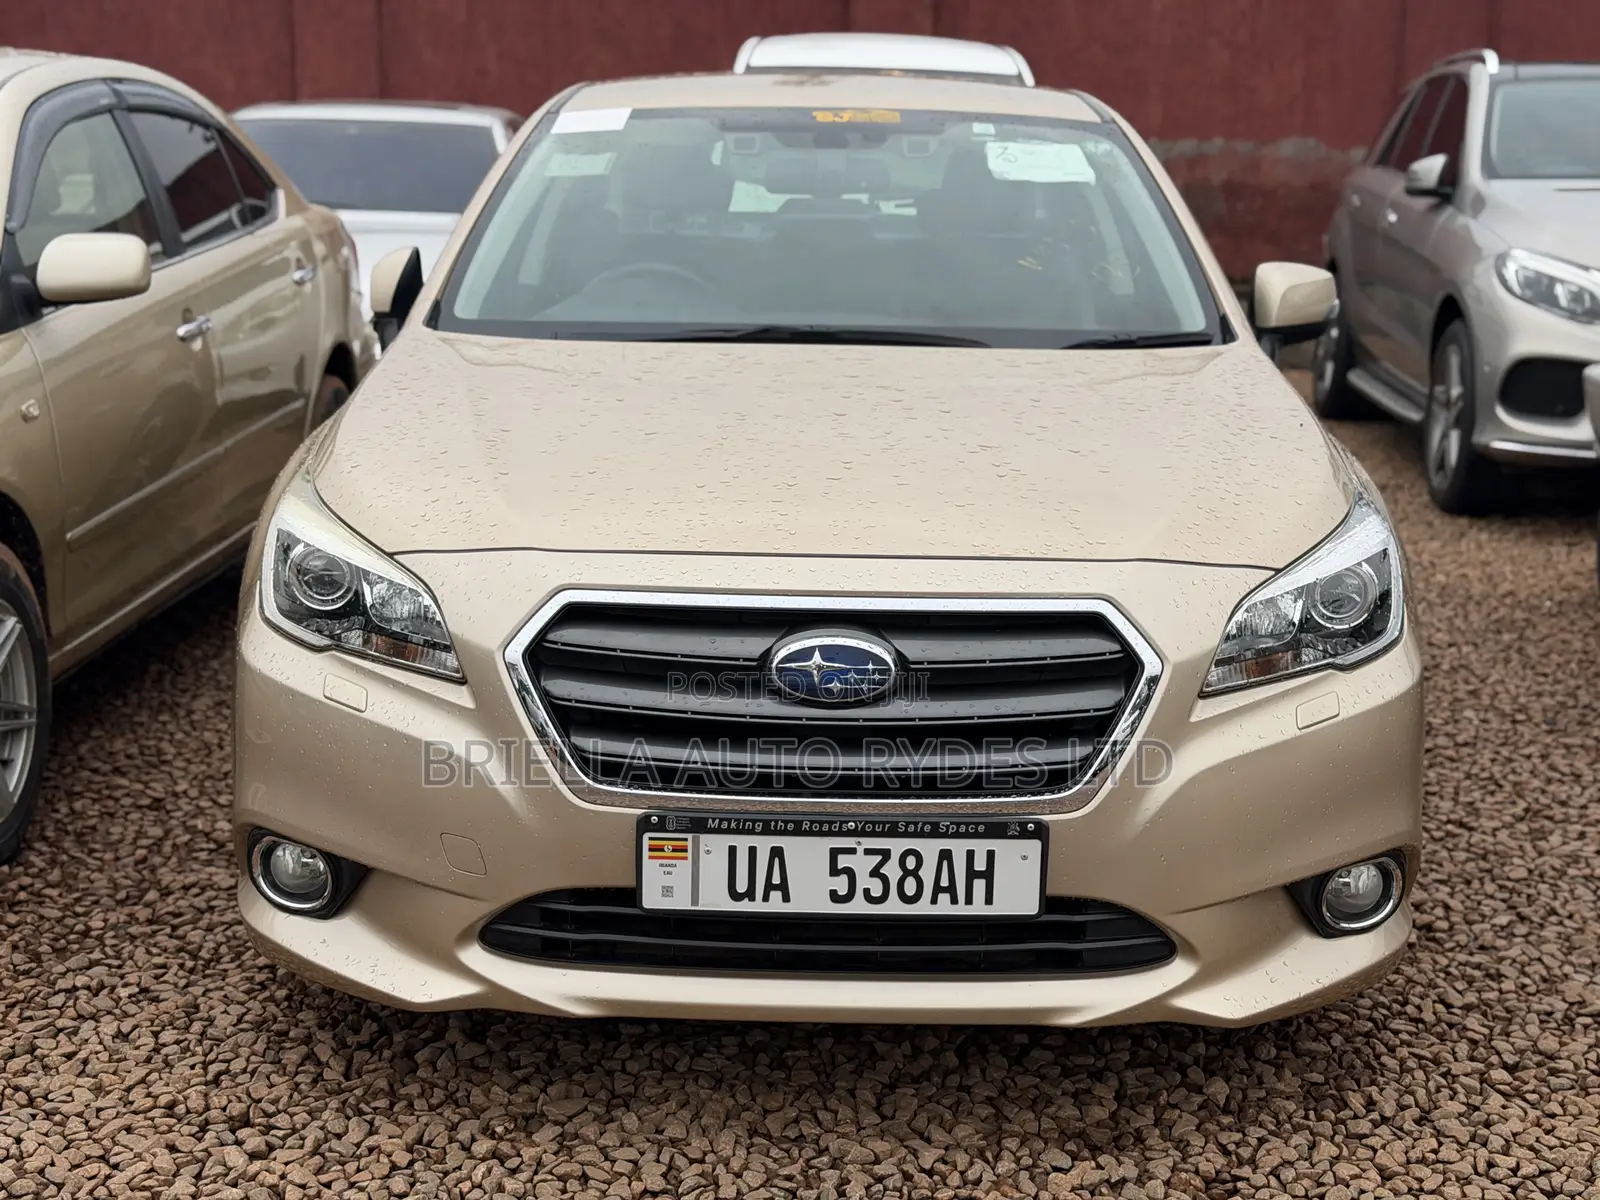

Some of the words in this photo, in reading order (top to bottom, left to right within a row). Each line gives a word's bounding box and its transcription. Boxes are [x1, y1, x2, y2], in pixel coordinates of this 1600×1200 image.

[707, 818, 763, 833] Making
[770, 820, 794, 831] the
[802, 820, 849, 832] Roads
[857, 821, 891, 832] Your
[897, 822, 931, 832] Safe
[938, 822, 986, 835] Space
[727, 844, 791, 903] UA
[828, 846, 996, 906] 538AH
